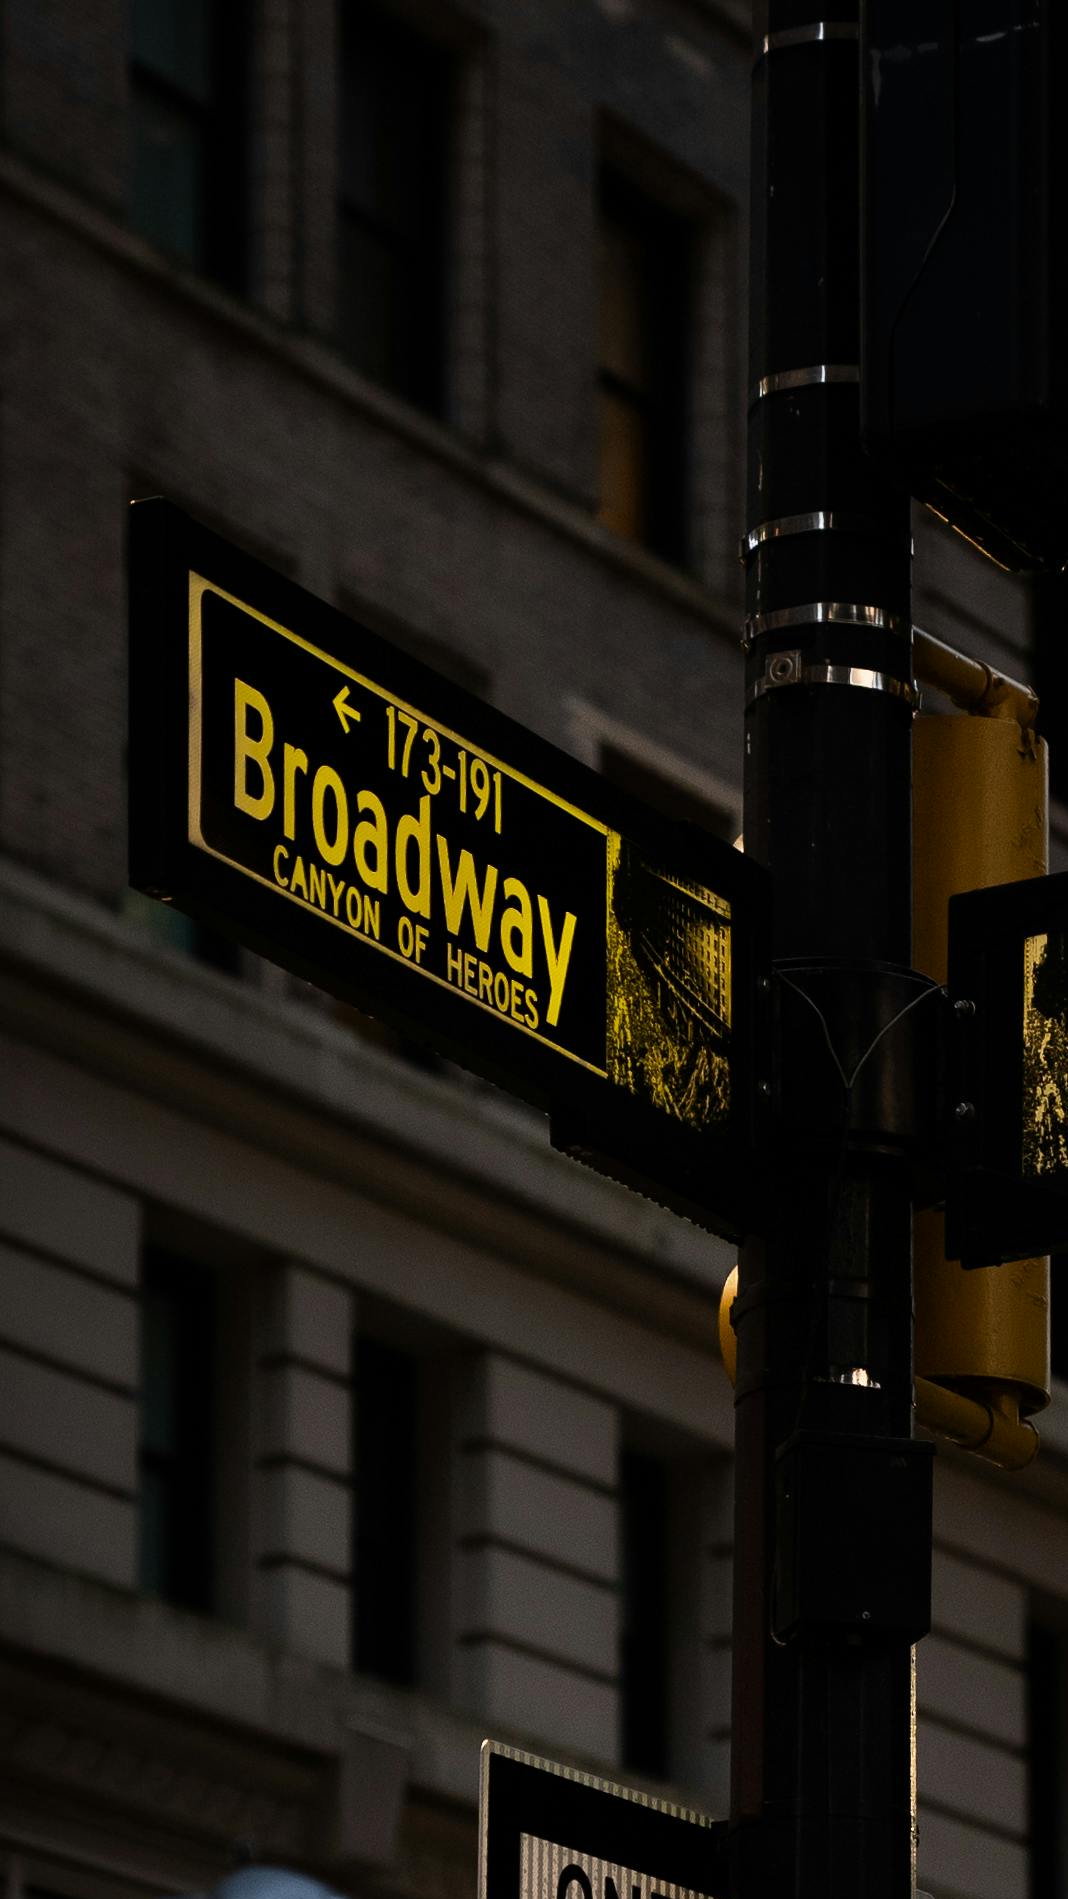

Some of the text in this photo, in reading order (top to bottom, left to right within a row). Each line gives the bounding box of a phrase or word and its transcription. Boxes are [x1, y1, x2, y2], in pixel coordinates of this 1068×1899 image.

[233, 676, 577, 1027] Broadway
[384, 705, 503, 836] 173-191
[272, 842, 541, 1032] CANYON OF HEROES
